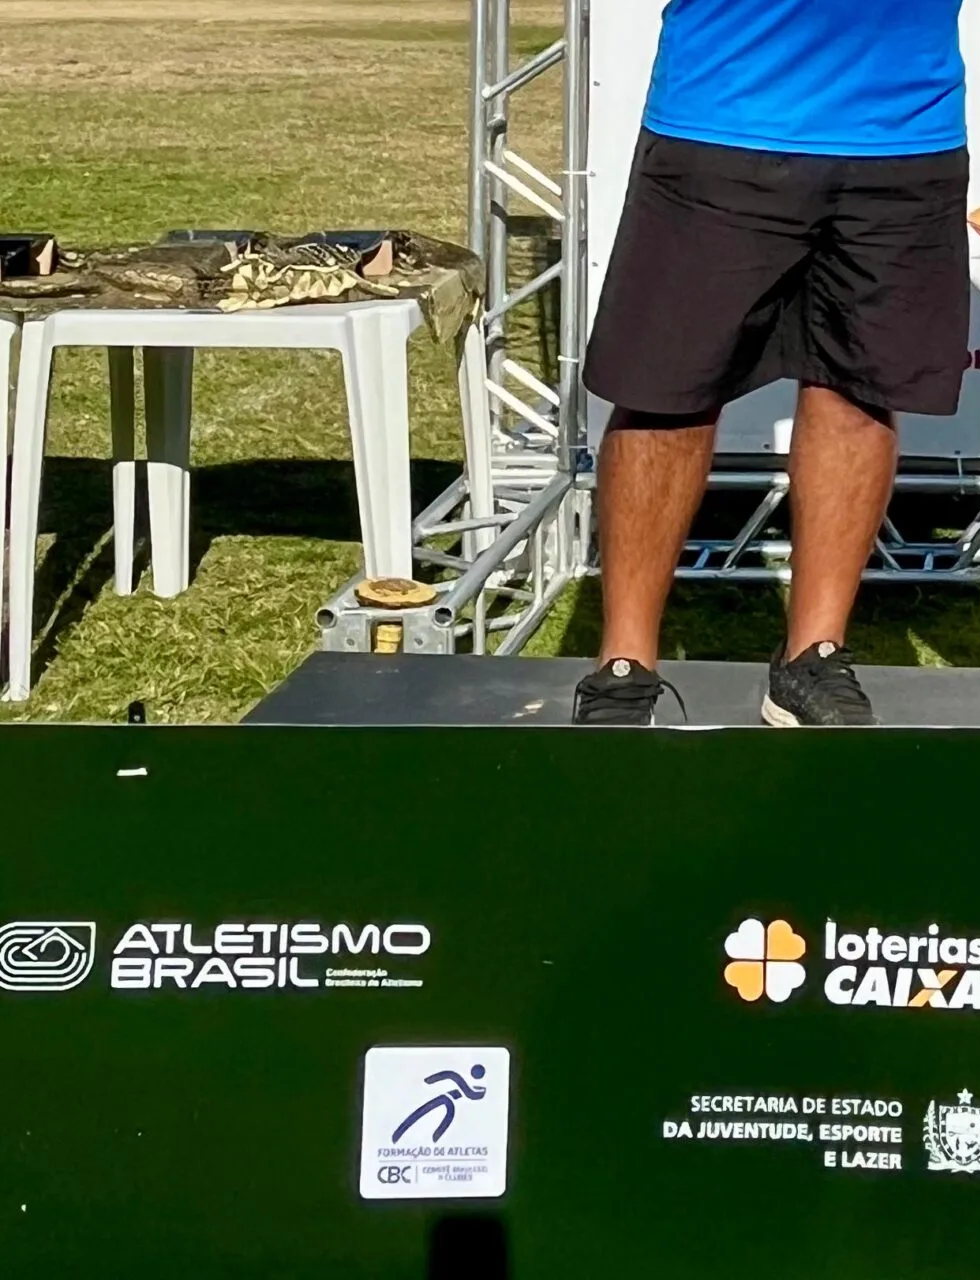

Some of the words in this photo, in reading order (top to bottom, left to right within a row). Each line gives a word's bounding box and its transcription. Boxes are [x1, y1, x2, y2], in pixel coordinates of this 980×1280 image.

[114, 924, 430, 955] ATLETISMO
[111, 956, 319, 988] BRASIL
[691, 1096, 798, 1113] SECRETARIA
[803, 1097, 826, 1113] DE
[832, 1099, 902, 1116] ESTADO
[663, 1121, 693, 1138] DA
[697, 1123, 812, 1142] JUVENTUDE,
[819, 1124, 902, 1143] ESPORTE
[825, 1153, 836, 1167] E
[842, 1151, 902, 1169] LAZER
[377, 1166, 411, 1183] CBC
